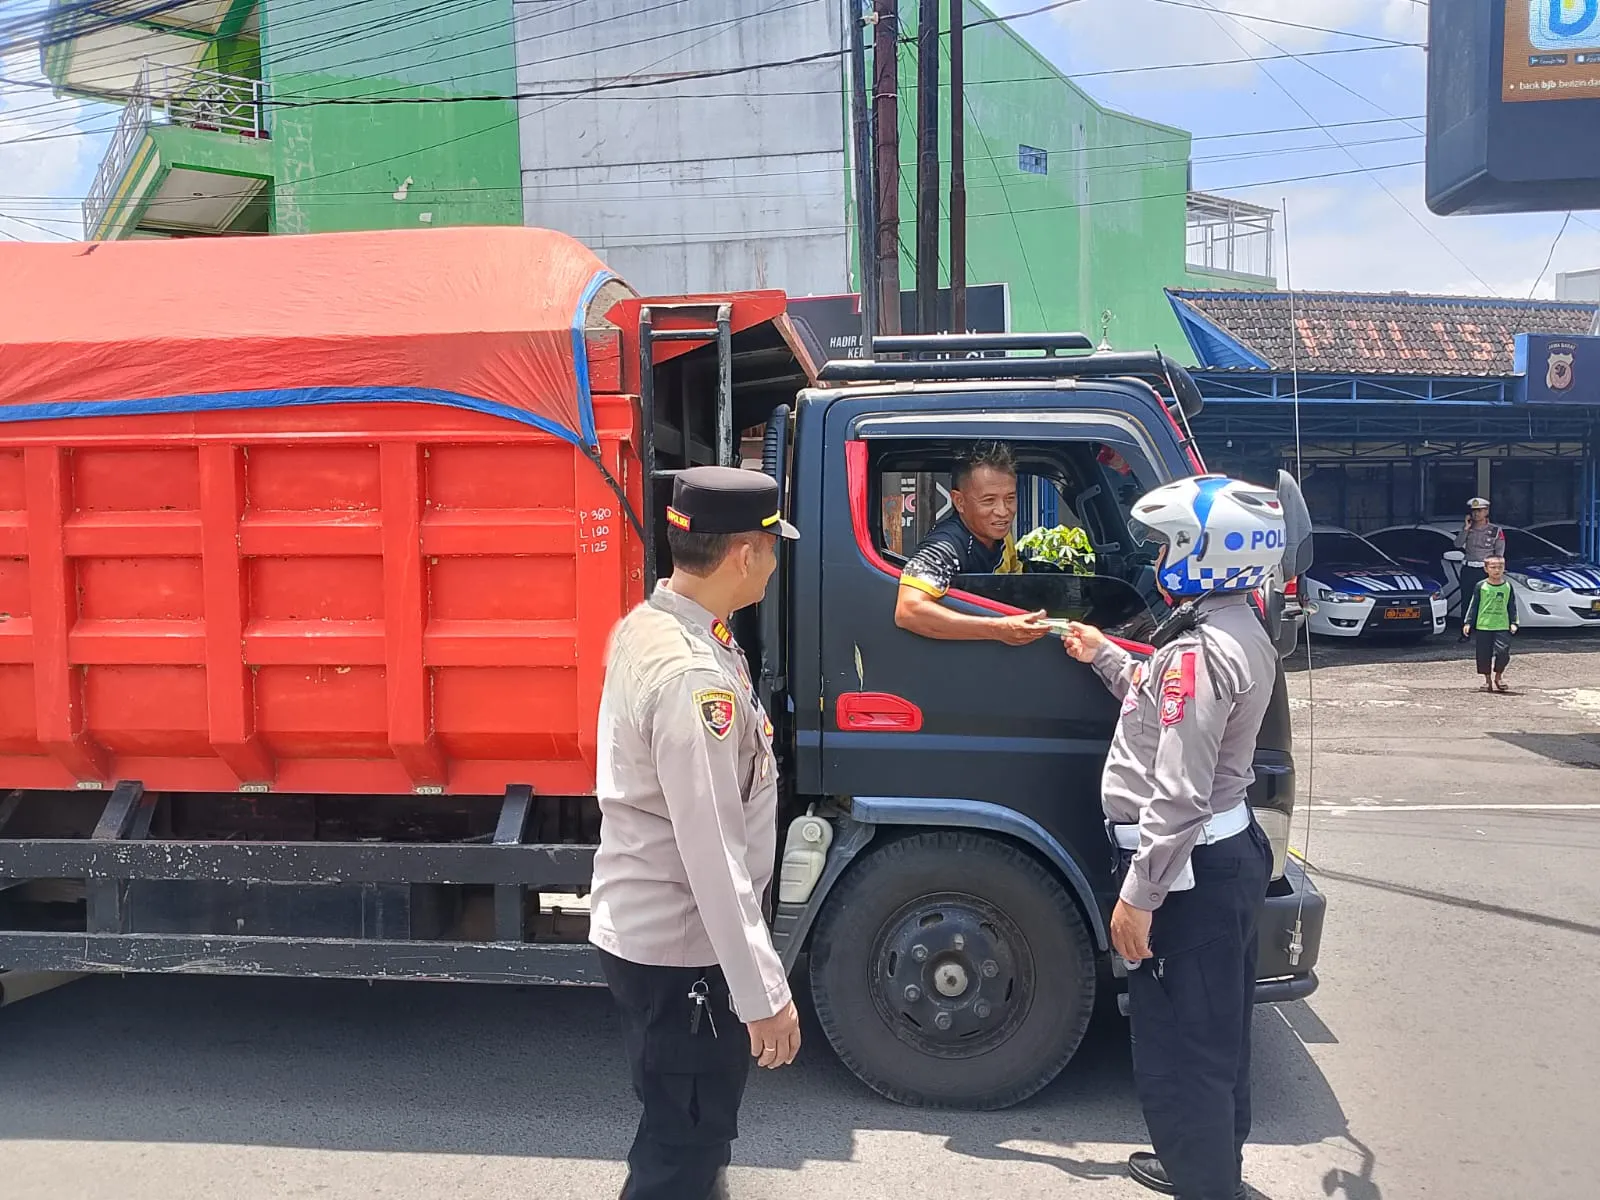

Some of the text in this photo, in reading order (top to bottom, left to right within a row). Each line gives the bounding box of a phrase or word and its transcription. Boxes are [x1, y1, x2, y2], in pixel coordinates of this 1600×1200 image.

[1519, 81, 1540, 90] bank
[1541, 80, 1557, 90] bjb
[830, 335, 857, 348] HADIR
[579, 507, 612, 525] P 380
[580, 528, 588, 539] L
[591, 540, 608, 553] 125
